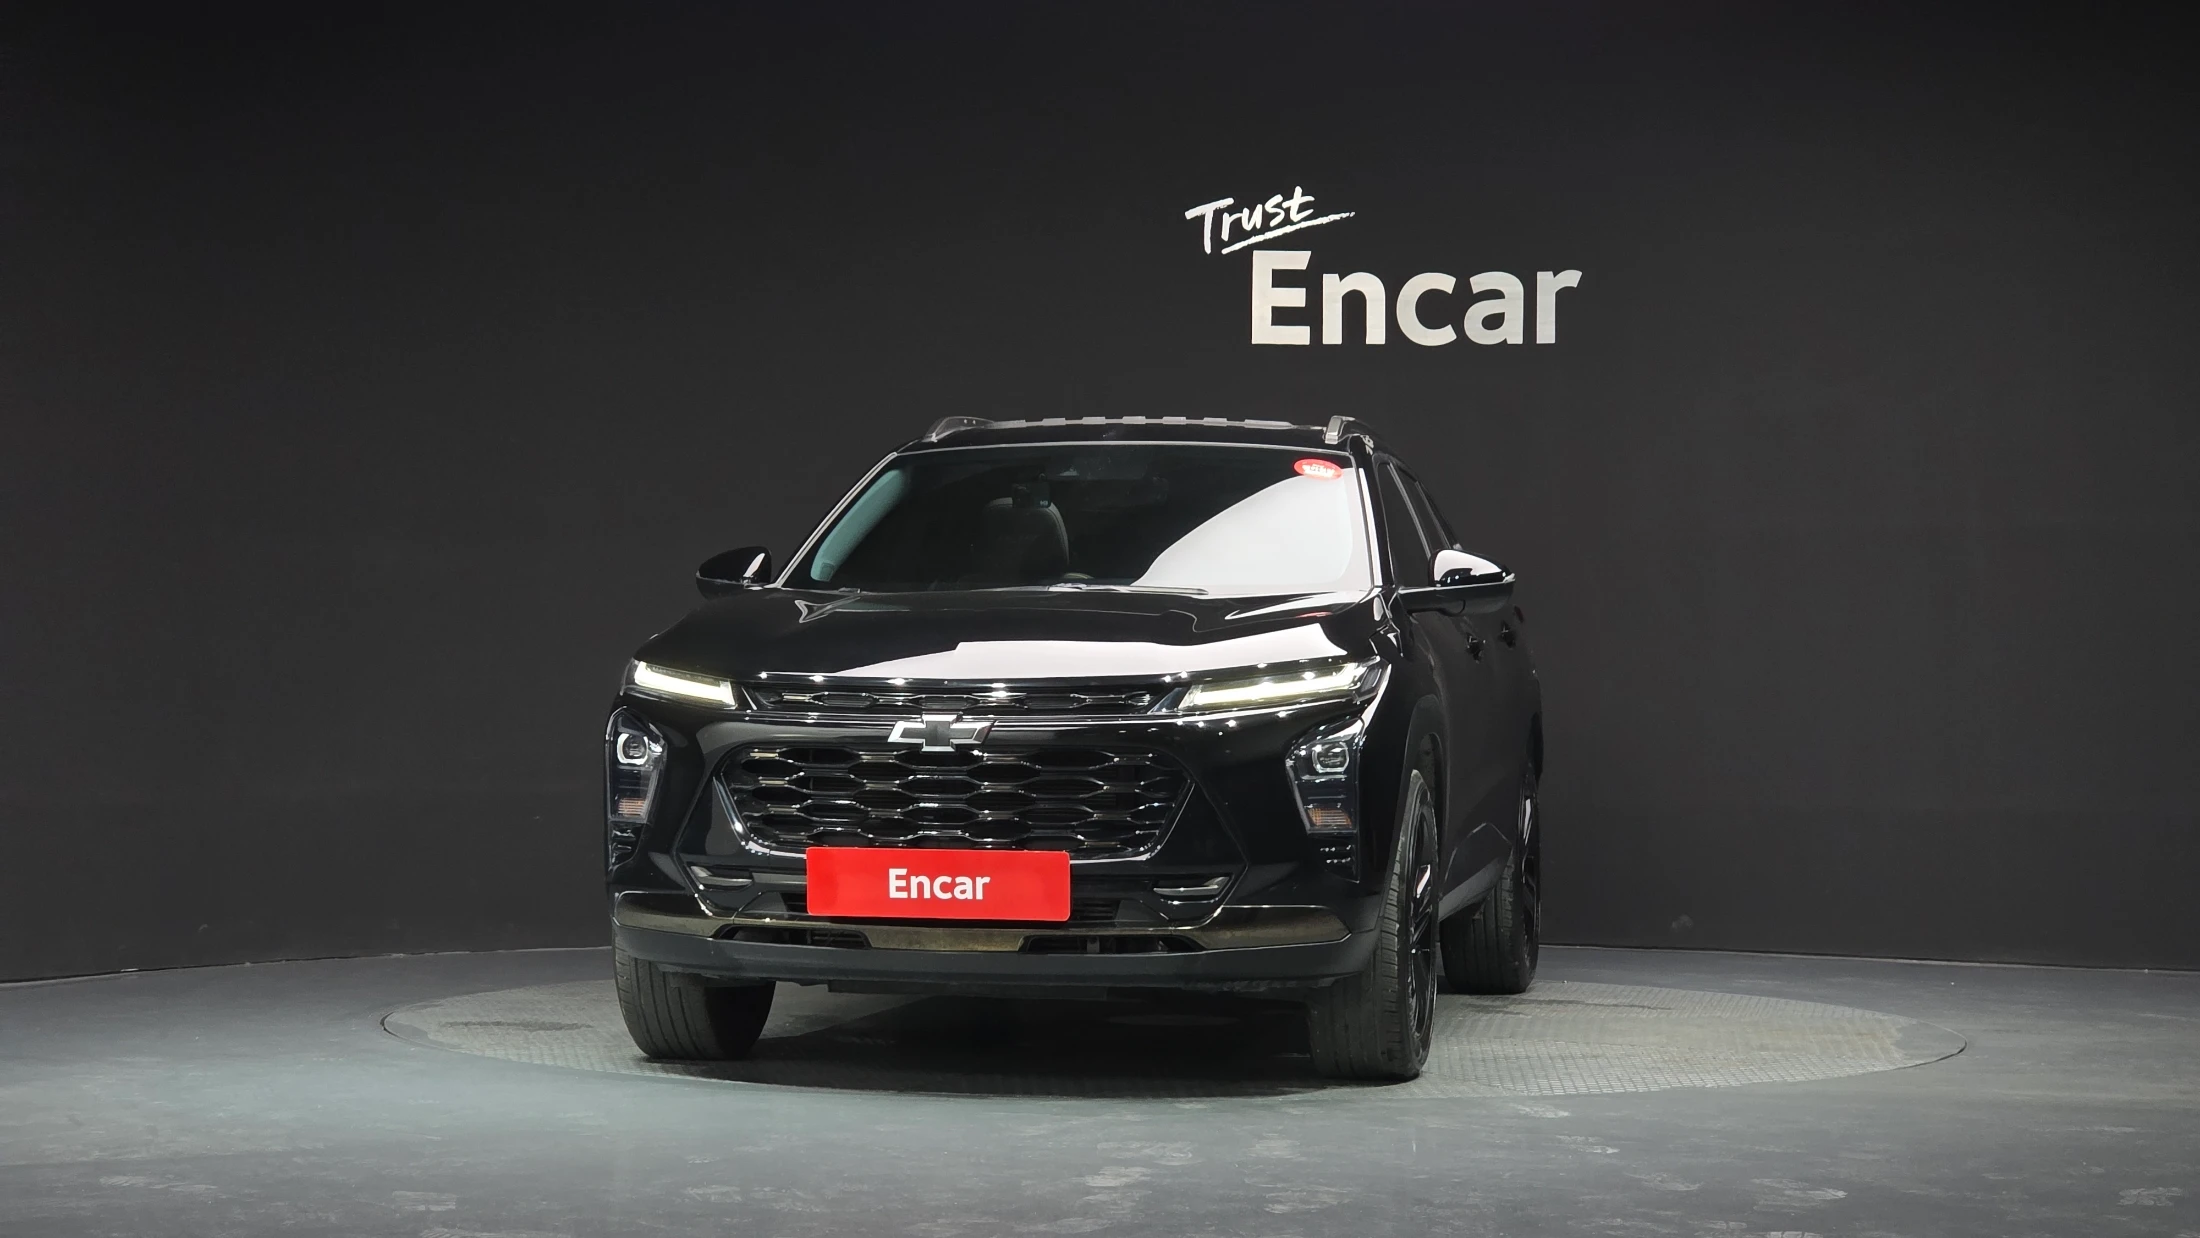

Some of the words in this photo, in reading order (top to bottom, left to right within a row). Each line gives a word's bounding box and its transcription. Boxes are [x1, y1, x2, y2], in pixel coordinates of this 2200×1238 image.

[1184, 186, 1316, 254] Trust
[1251, 249, 1583, 347] Encar
[888, 867, 991, 901] Encar
